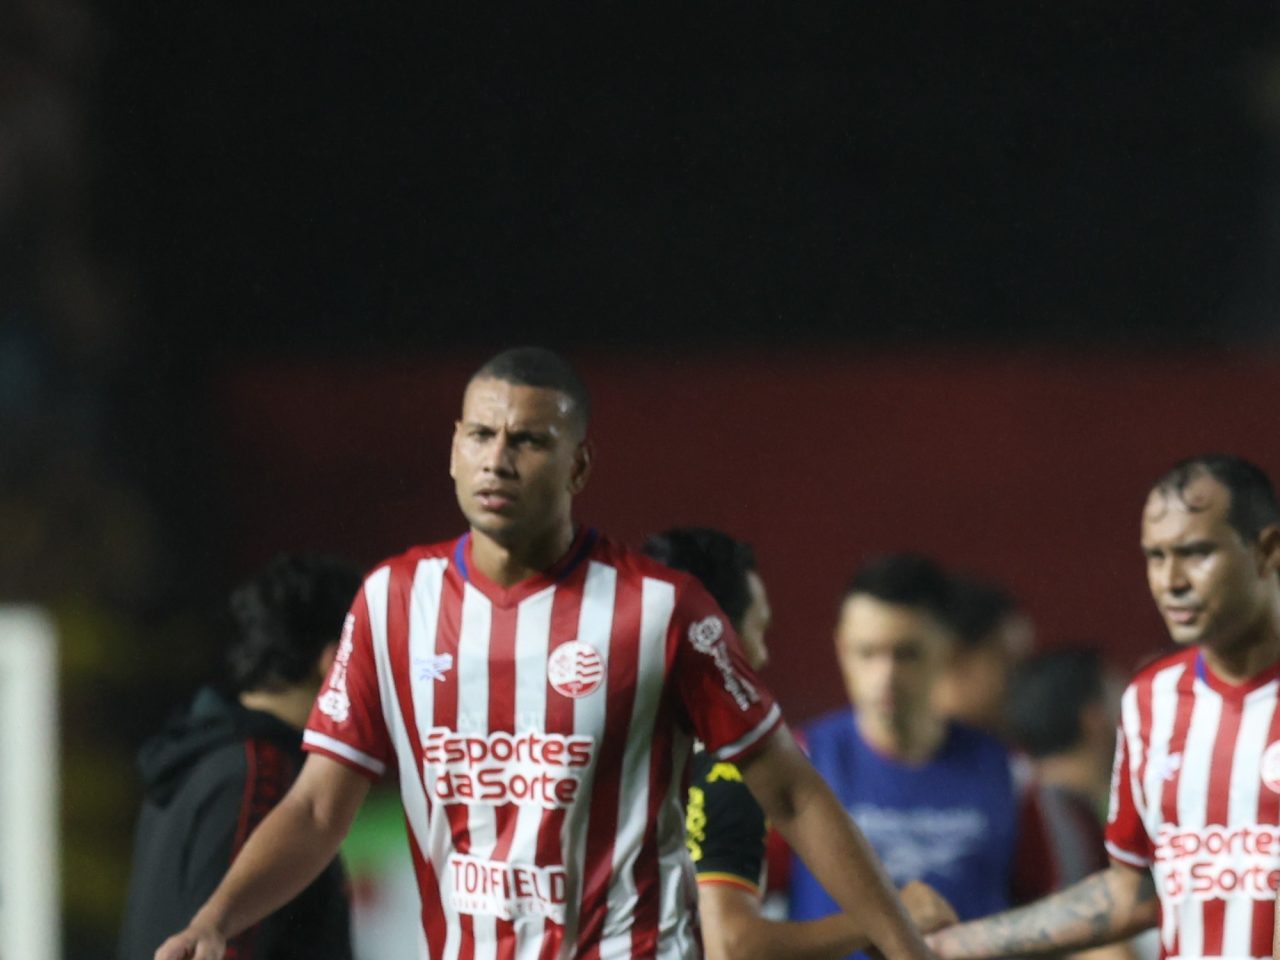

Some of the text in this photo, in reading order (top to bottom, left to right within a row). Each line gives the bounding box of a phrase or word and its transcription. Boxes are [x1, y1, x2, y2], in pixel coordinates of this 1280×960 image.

[423, 733, 593, 768] Esportes
[435, 768, 578, 804] da Sorte
